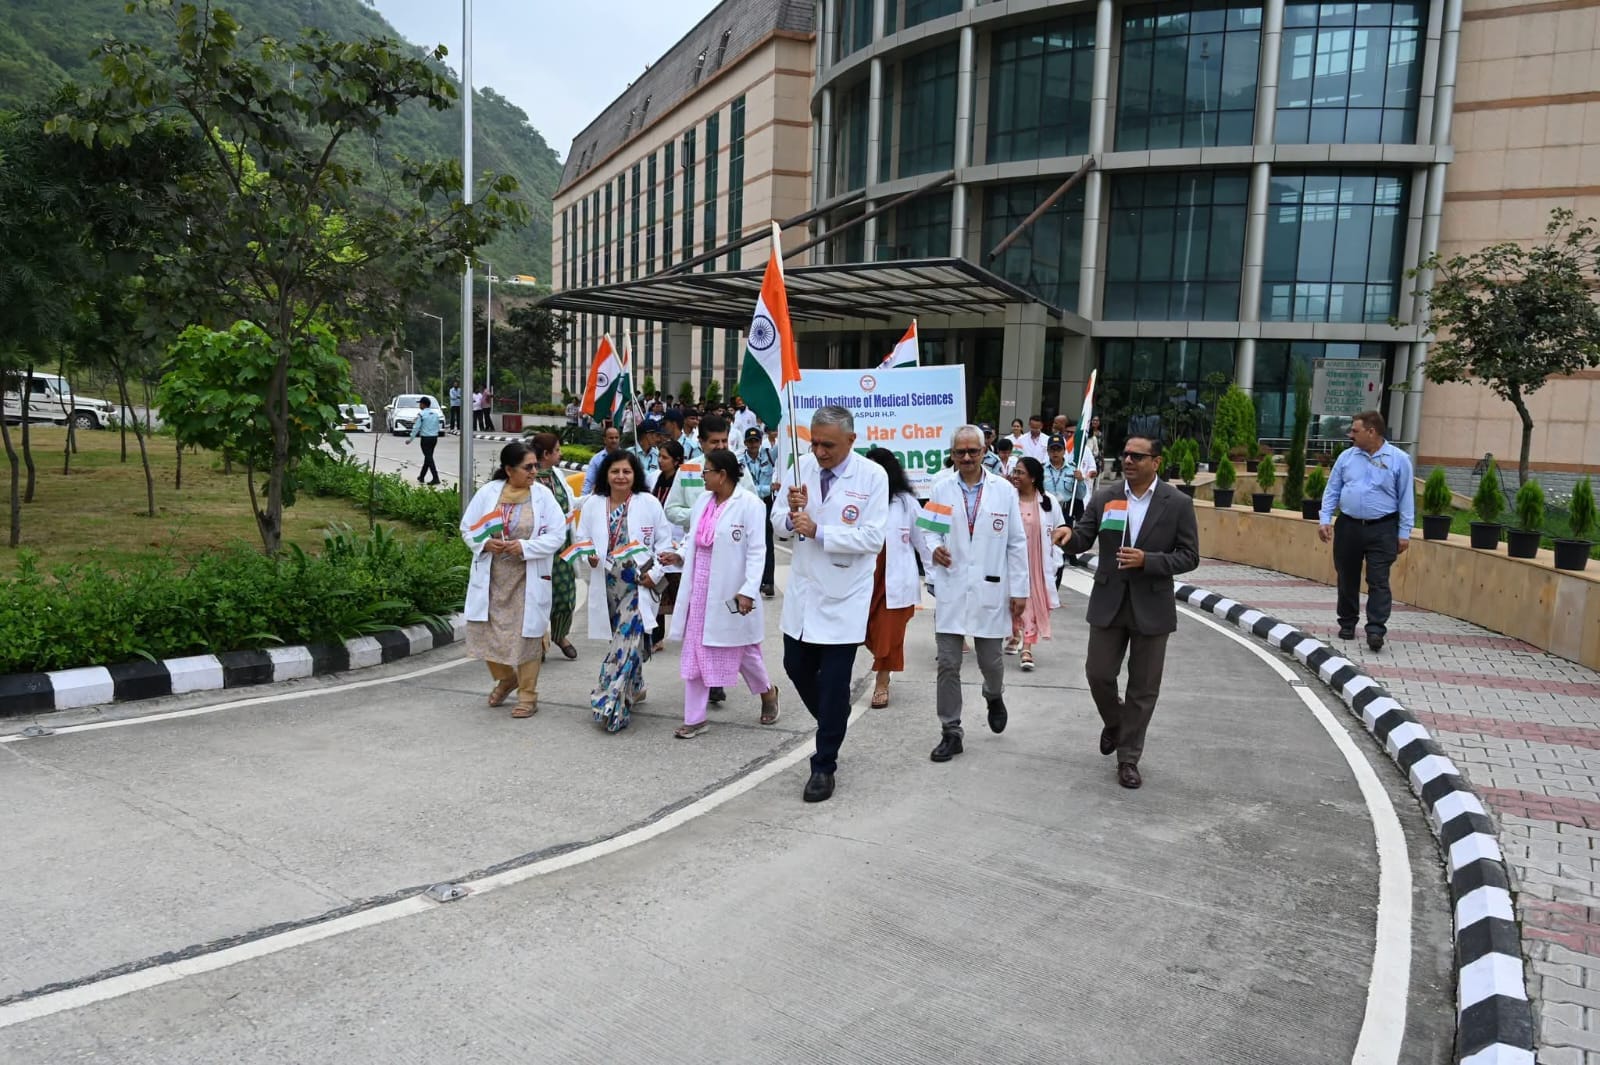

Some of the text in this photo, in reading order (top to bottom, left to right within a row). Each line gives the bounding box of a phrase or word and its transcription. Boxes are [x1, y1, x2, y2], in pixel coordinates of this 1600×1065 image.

[801, 395, 823, 409] India
[825, 394, 862, 409] Institute
[864, 393, 873, 408] of
[874, 392, 910, 408] Medical
[911, 392, 954, 407] Sciences
[866, 423, 943, 441] Har Ghar
